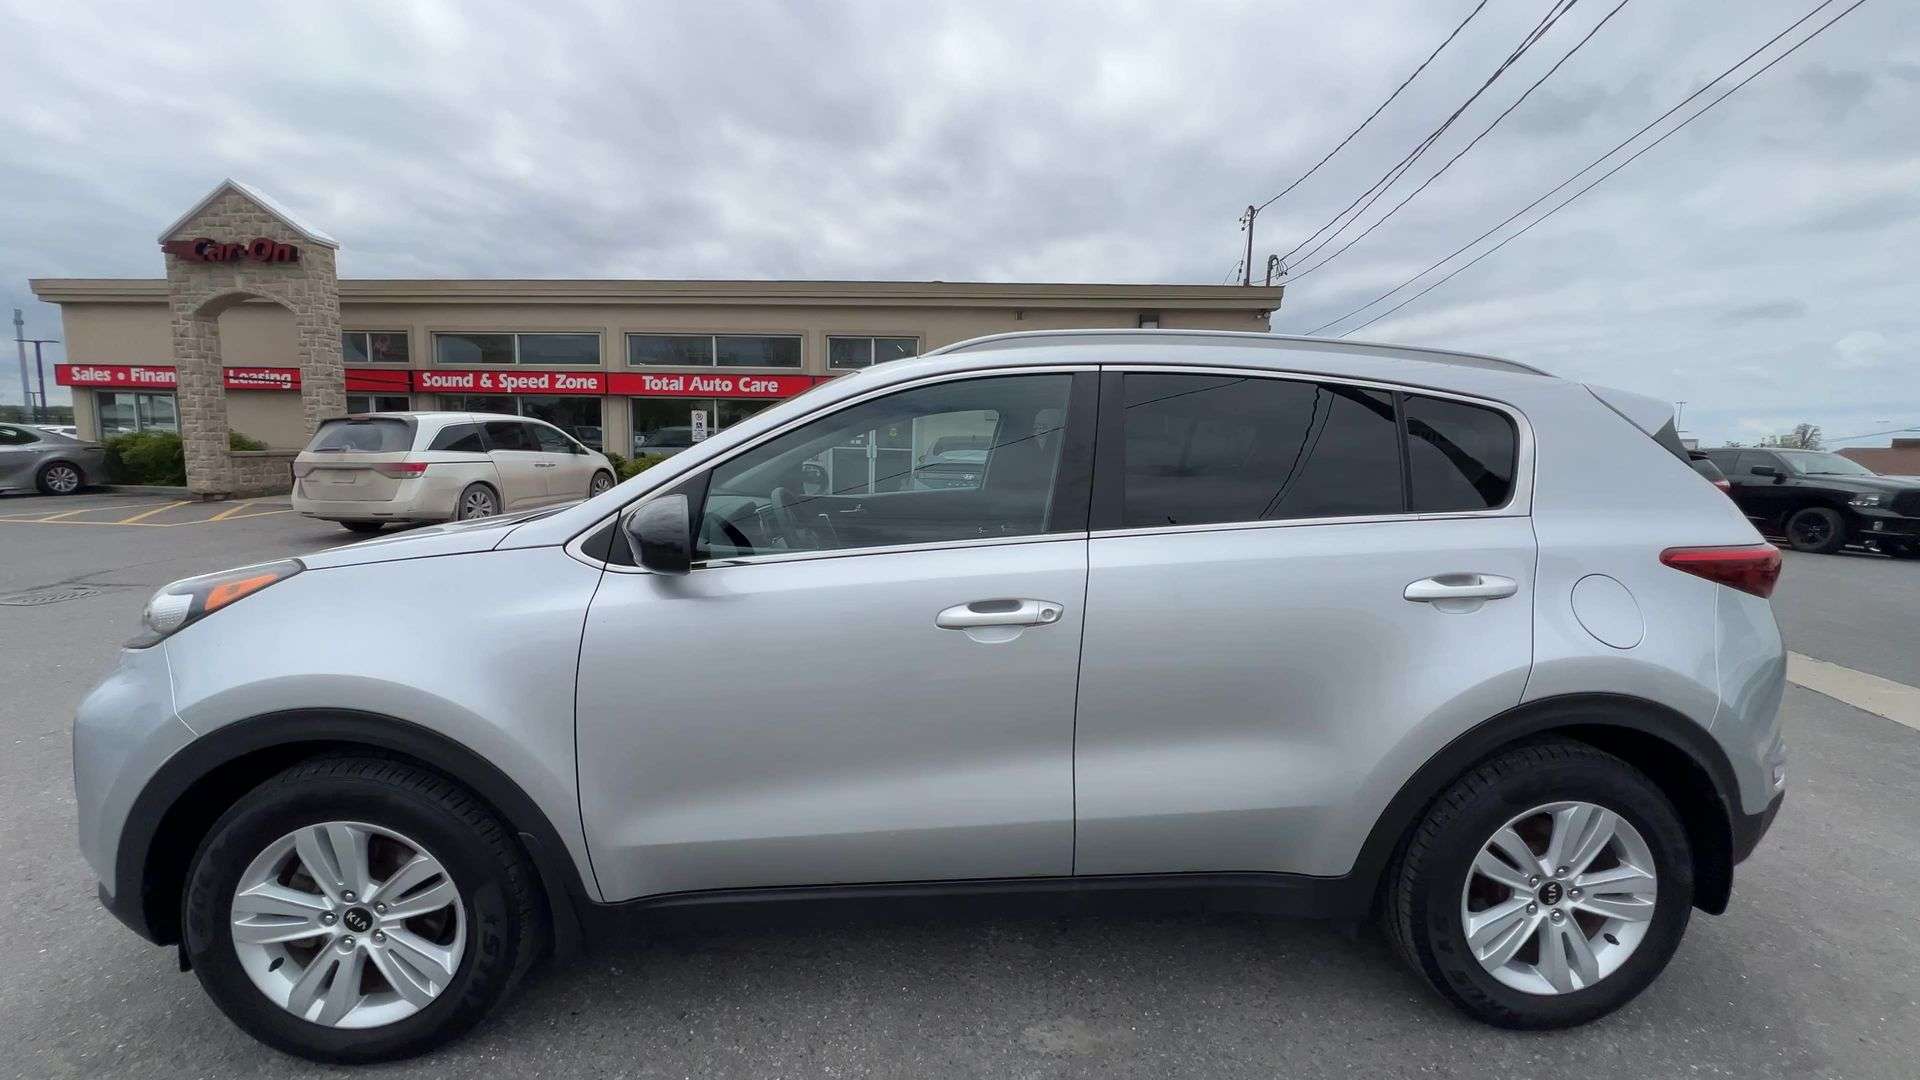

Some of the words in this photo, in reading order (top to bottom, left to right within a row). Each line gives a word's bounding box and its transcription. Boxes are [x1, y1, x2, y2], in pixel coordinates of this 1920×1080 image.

[71, 366, 111, 382] Sales
[228, 369, 292, 389] Leasing
[422, 372, 474, 388] Sound
[480, 373, 493, 388] &
[498, 373, 549, 393] Speed
[555, 374, 598, 389] Zone
[642, 375, 684, 391] Total
[688, 376, 733, 392] Auto
[738, 377, 779, 393] Care
[346, 911, 368, 930] KIA
